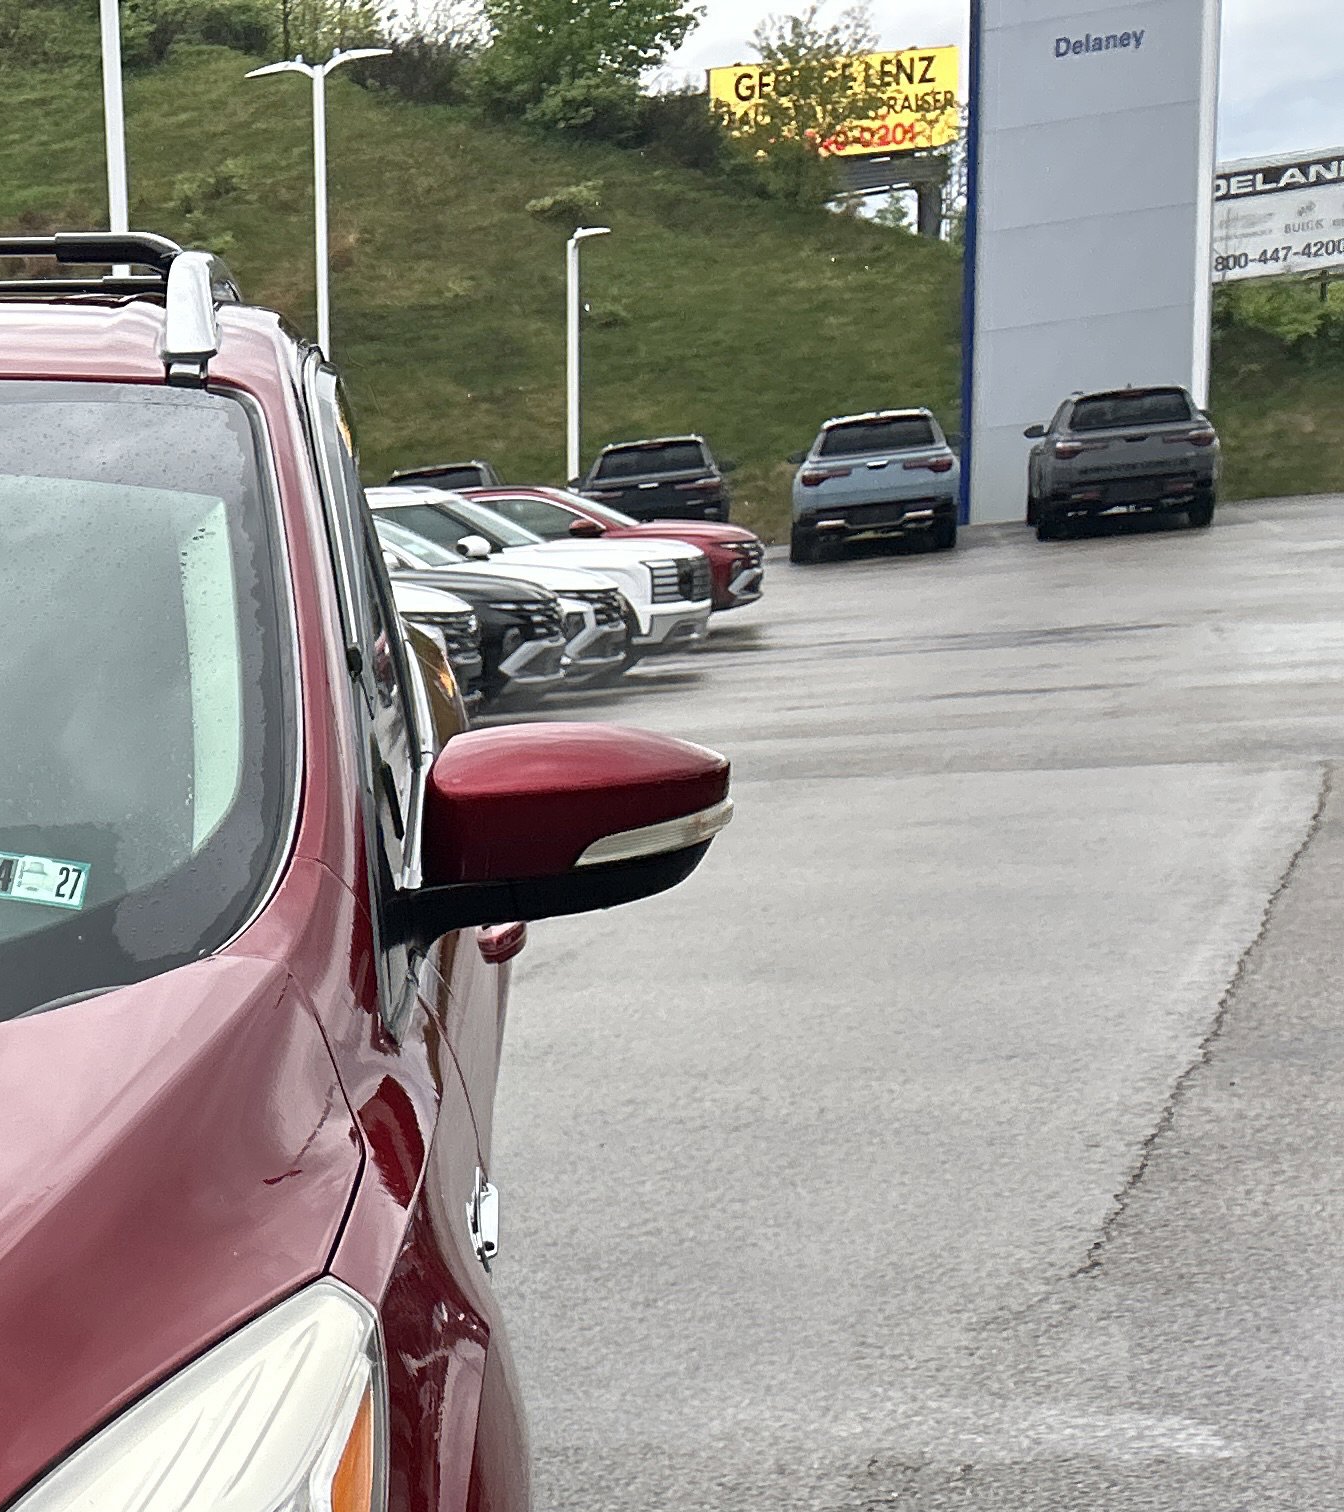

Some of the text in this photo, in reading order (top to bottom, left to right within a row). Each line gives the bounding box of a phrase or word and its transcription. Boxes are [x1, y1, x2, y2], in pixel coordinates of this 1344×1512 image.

[1055, 29, 1145, 58] Delaney
[1215, 160, 1344, 197] DELAN
[1284, 219, 1323, 234] BUICK
[55, 866, 82, 900] 27
